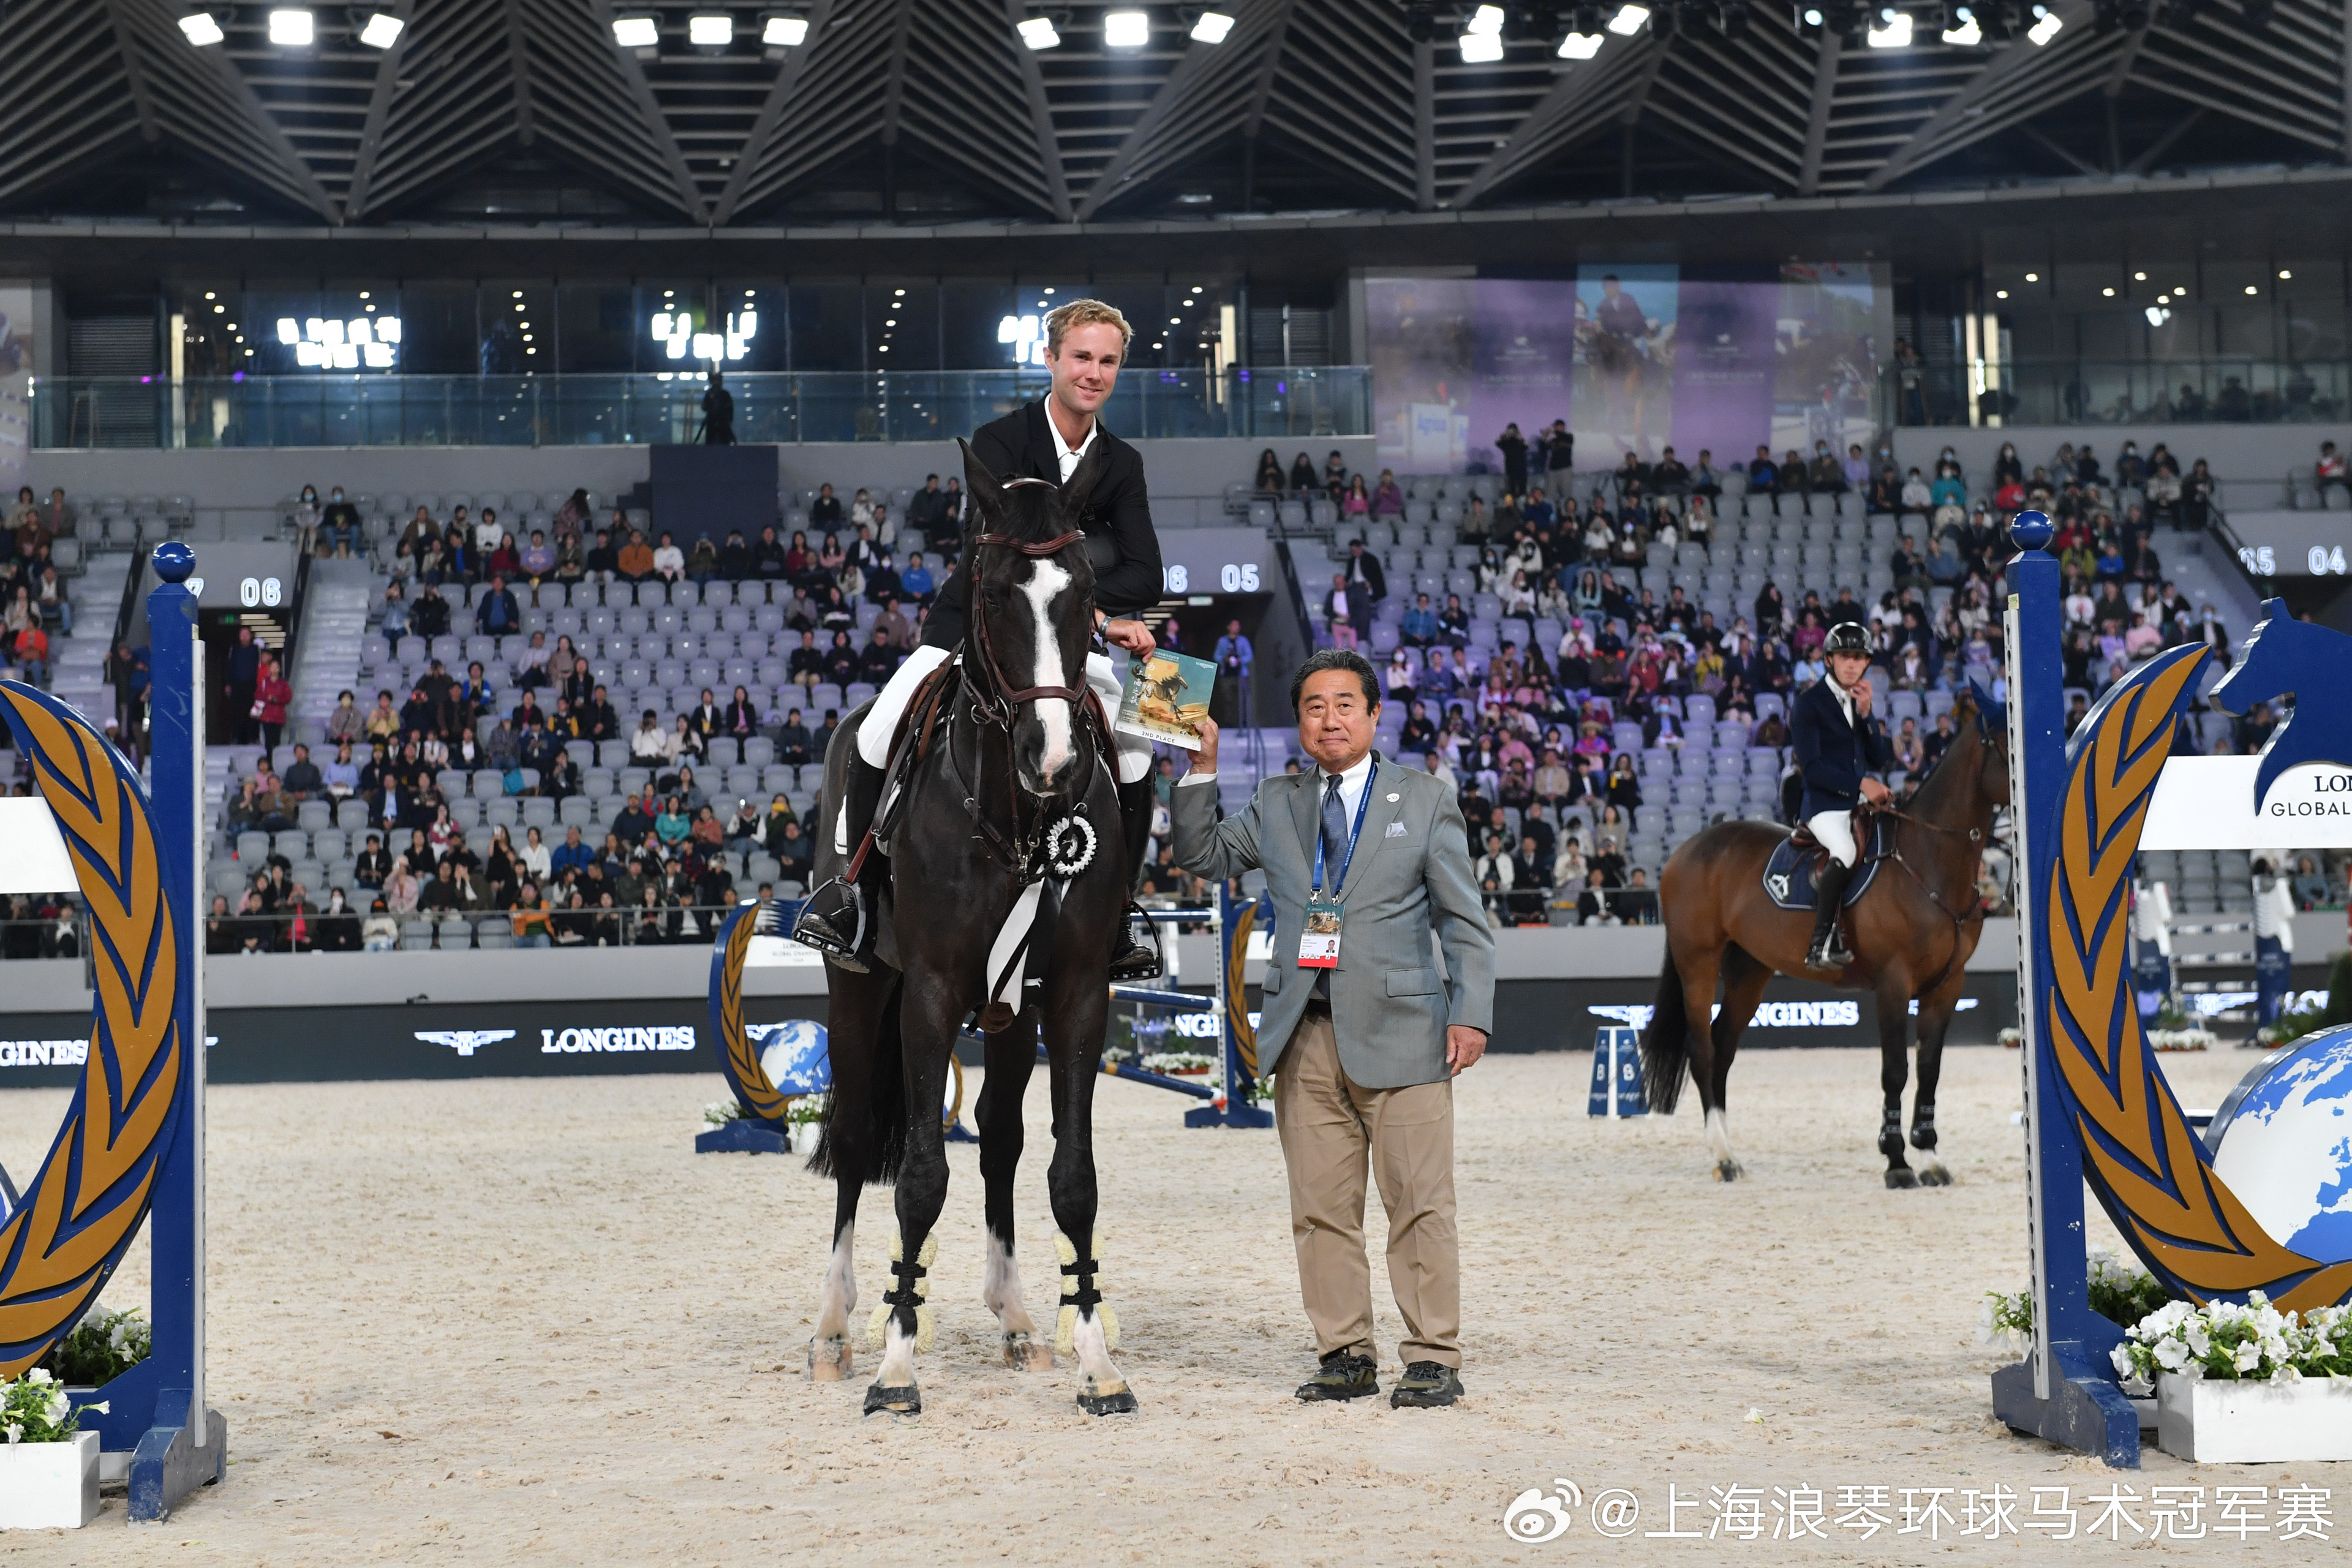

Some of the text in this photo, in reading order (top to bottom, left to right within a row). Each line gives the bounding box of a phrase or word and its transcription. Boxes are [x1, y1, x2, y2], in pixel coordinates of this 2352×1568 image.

[2308, 545, 2347, 576] 04
[1163, 565, 1188, 593] 6
[1221, 564, 1260, 592] 05
[241, 577, 281, 607] 06
[1156, 734, 1175, 743] PLACE
[2271, 802, 2351, 816] GLOBAL
[0, 1039, 89, 1066] GINES
[541, 1026, 696, 1053] LONGINES
